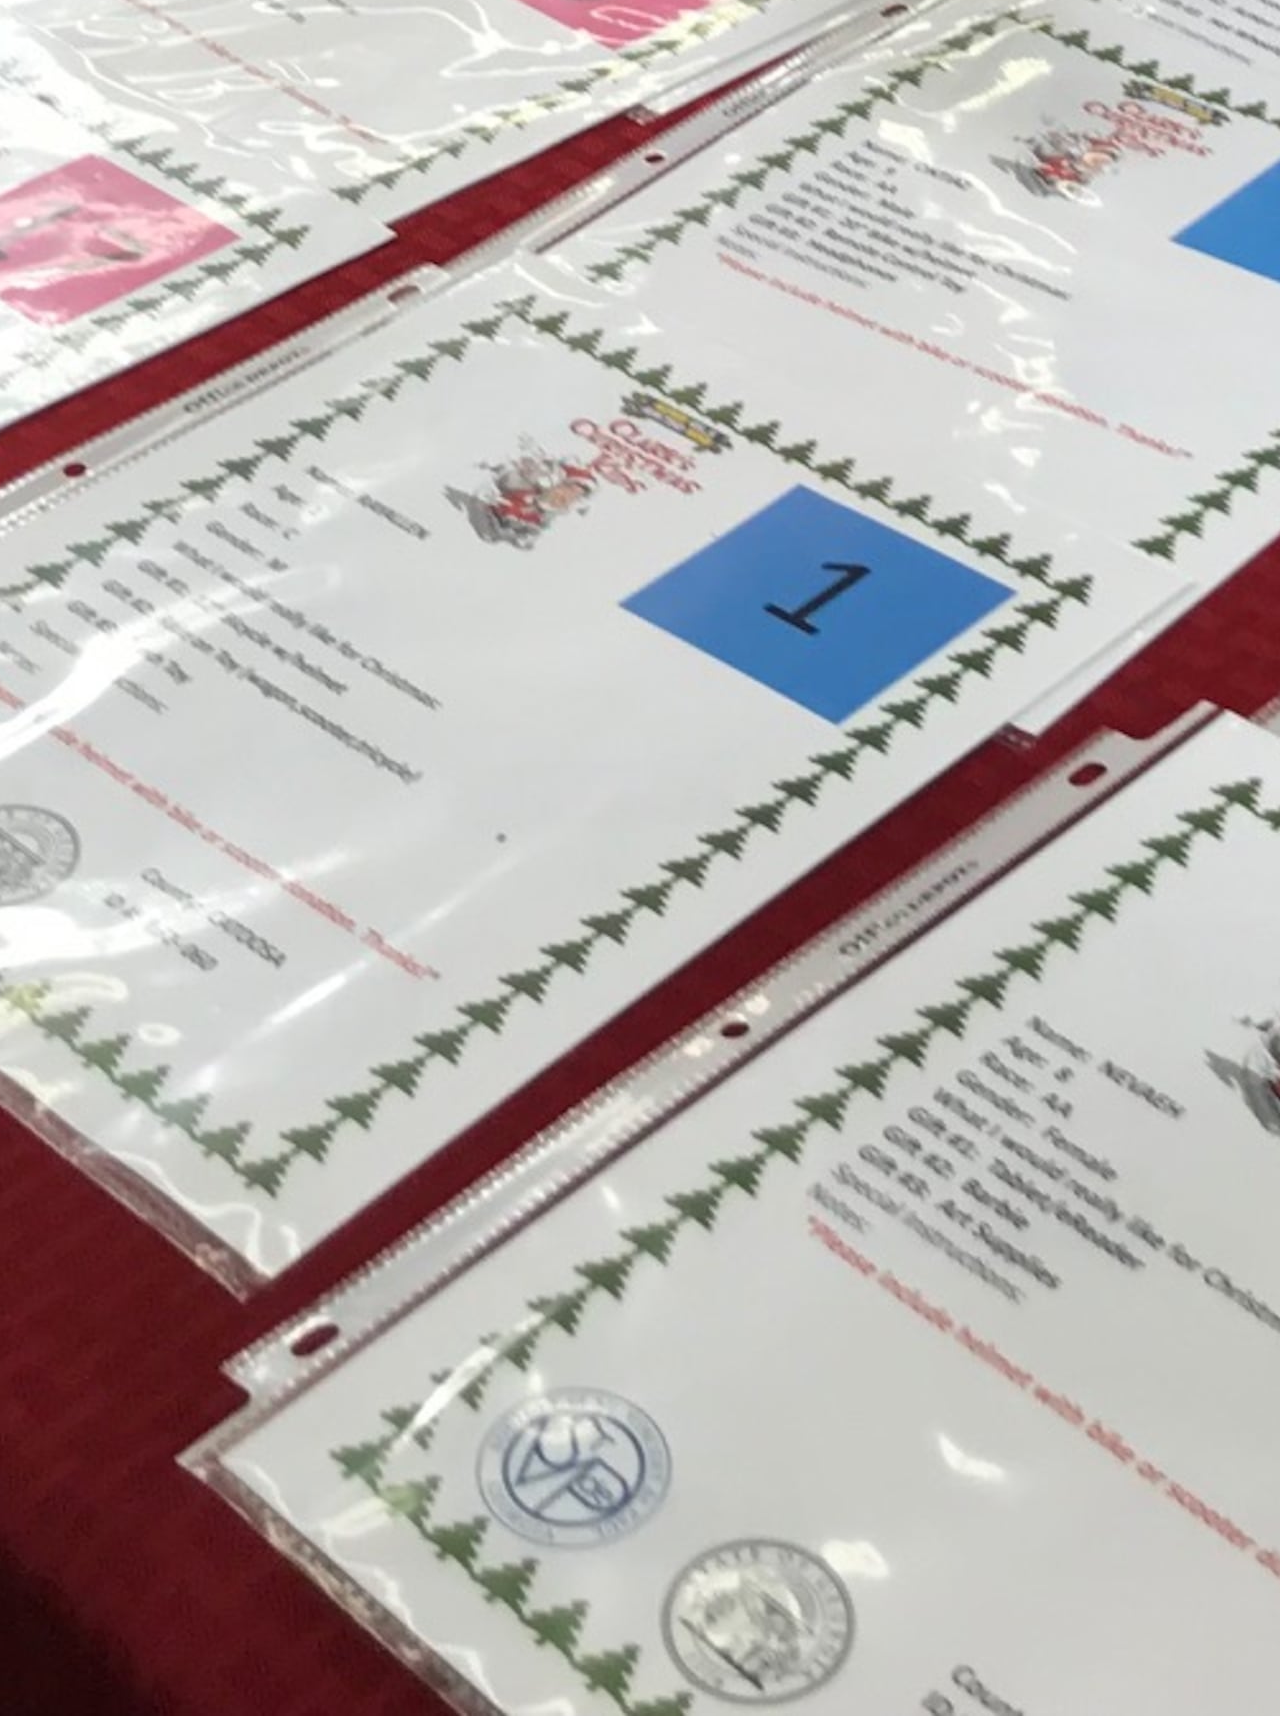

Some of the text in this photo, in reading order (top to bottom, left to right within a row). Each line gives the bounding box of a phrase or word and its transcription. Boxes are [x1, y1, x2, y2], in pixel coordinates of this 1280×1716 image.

[762, 561, 872, 637] 1
[978, 1051, 1076, 1118] Race: AA
[1000, 1033, 1049, 1070] Age:
[1025, 1016, 1184, 1120] Name: NEVAEH
[905, 1104, 949, 1136] Gift
[955, 1068, 1119, 1181] Gender: Female
[855, 1143, 900, 1176] Gift
[934, 1197, 974, 1227] Art
[972, 1224, 1063, 1290] Supplies
[879, 1123, 924, 1156] Gift
[960, 1178, 1032, 1231] Barbie
[932, 1087, 991, 1130] What
[1000, 1133, 1065, 1180] would
[1061, 1176, 1125, 1223] really
[1124, 1217, 1169, 1250] like
[1165, 1243, 1205, 1273] for
[878, 1271, 955, 1332] include
[954, 1326, 1034, 1389] helmet
[1032, 1383, 1086, 1427] with
[1083, 1421, 1138, 1465] bike
